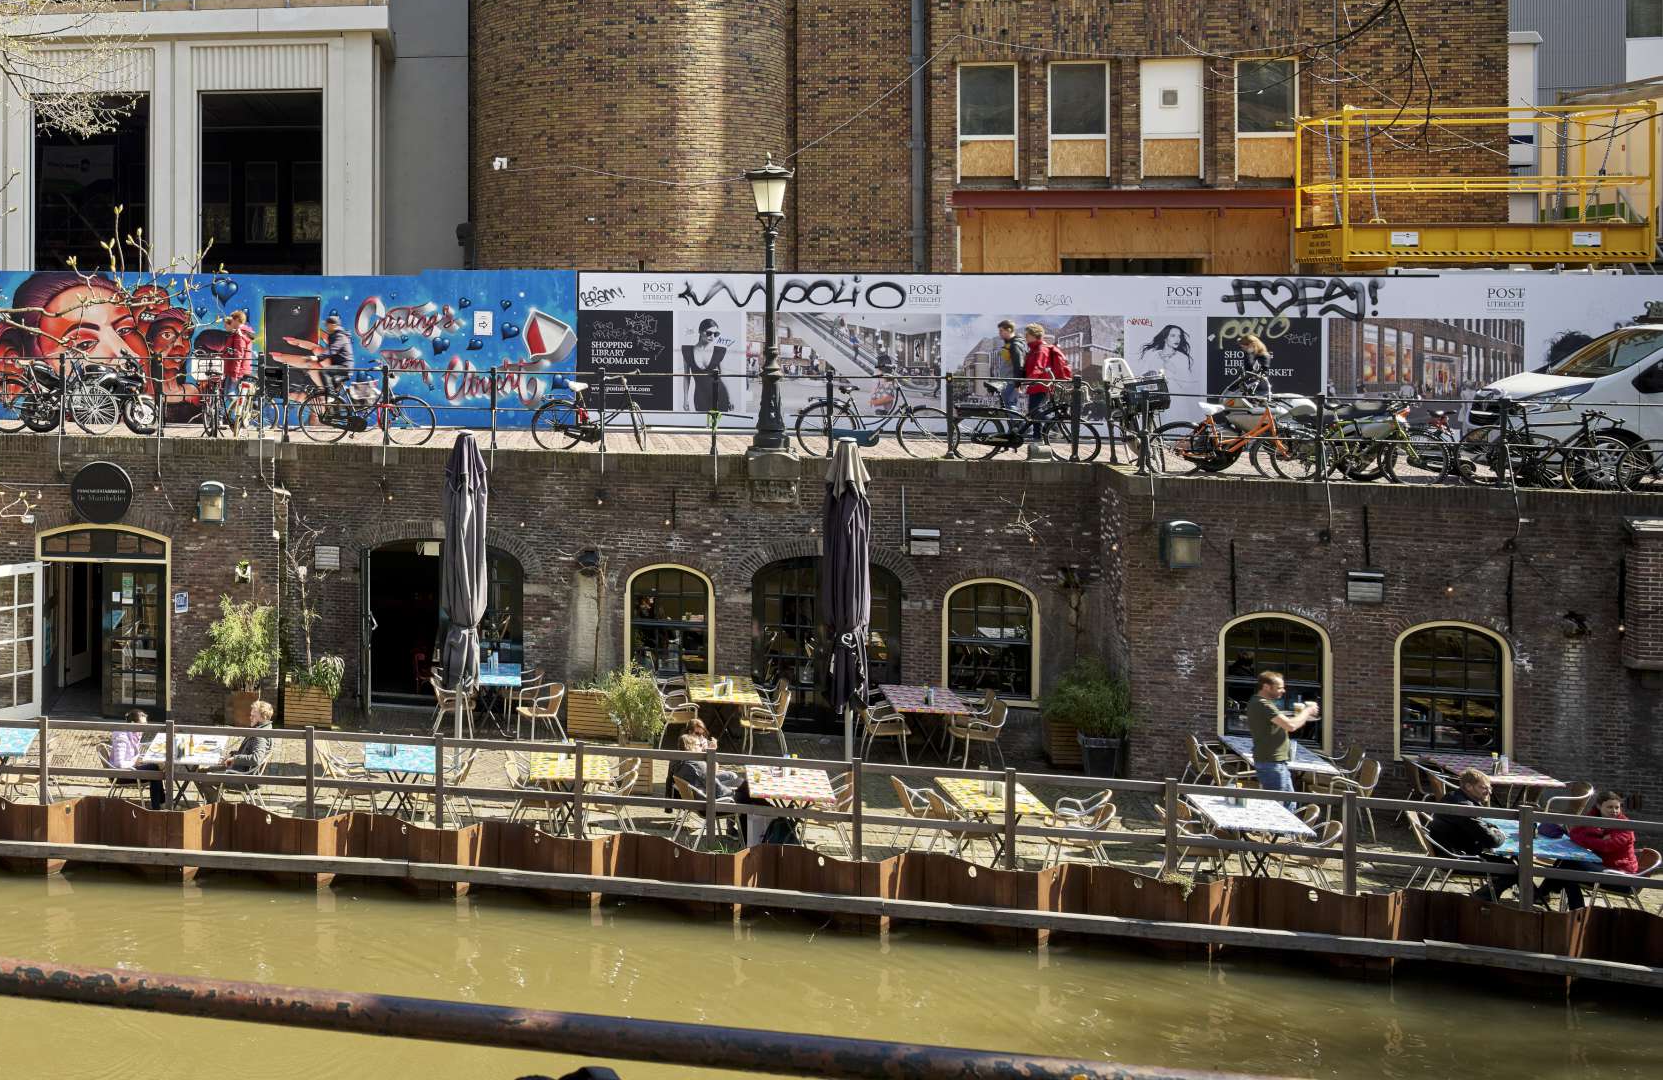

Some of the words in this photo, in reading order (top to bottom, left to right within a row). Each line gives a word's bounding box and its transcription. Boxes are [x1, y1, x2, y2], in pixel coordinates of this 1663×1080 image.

[643, 282, 673, 293] POST
[909, 284, 942, 295] POST
[1166, 286, 1203, 297] POST
[1487, 287, 1526, 299] POST
[591, 341, 633, 349] SHOPPING
[591, 349, 626, 357] LIBRARY
[591, 357, 650, 365] FOODMARKET
[1224, 367, 1294, 377] FORKET
